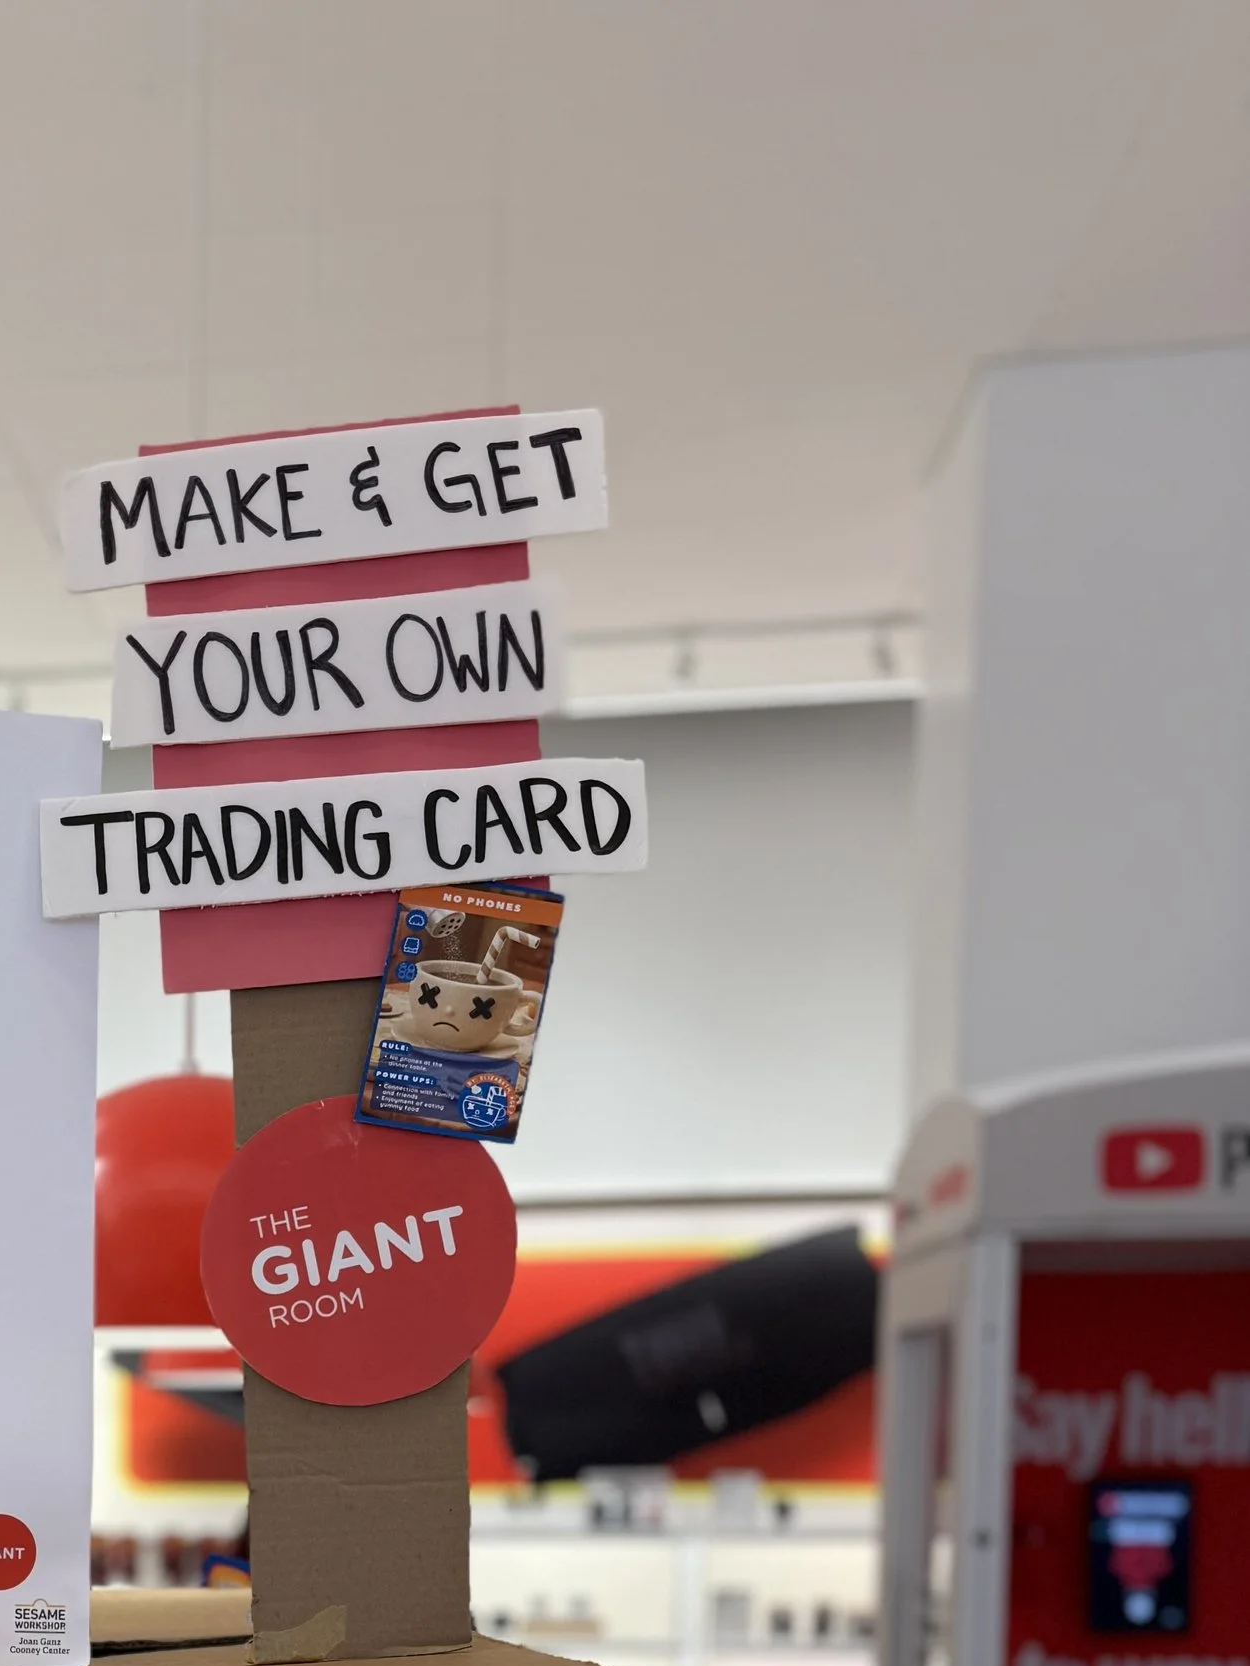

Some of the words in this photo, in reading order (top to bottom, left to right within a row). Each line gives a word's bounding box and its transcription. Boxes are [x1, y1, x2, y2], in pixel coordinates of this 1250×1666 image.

[100, 462, 322, 566] MAKE
[349, 445, 393, 527] &
[424, 426, 582, 516] GET
[126, 618, 364, 735] YOUR
[386, 610, 545, 702] OWN
[60, 800, 392, 896] TRADING
[424, 778, 632, 870] CARD
[443, 893, 462, 903] NO
[467, 896, 522, 913] PHONES
[250, 1206, 312, 1238] THE
[252, 1205, 464, 1295] GIANT
[269, 1288, 364, 1328] ROOM
[15, 1608, 65, 1620] SESAME
[15, 1621, 66, 1630] WORKSHOP
[10, 1646, 40, 1655] Cooney
[43, 1647, 70, 1655] Center
[19, 1637, 38, 1646] Joan
[40, 1638, 61, 1646] Ganz
